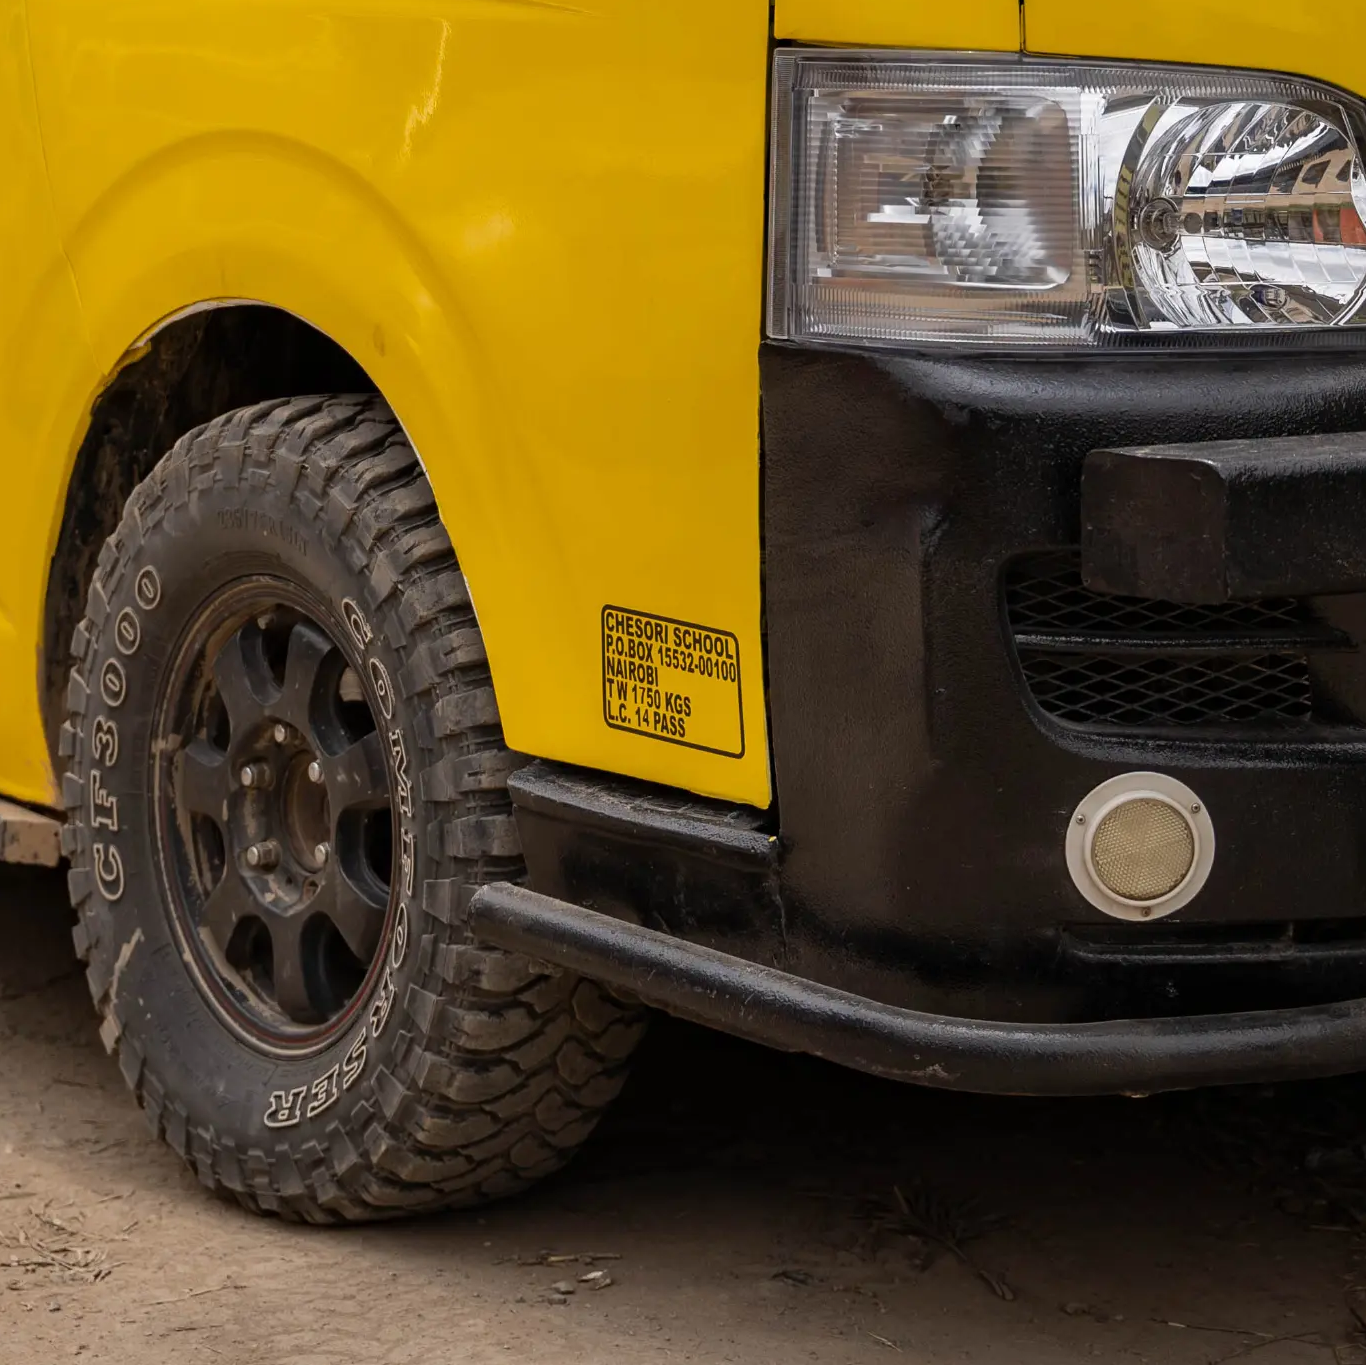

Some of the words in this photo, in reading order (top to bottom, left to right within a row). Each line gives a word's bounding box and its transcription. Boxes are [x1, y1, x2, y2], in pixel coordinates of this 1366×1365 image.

[605, 611, 669, 645] CHESORI
[673, 627, 734, 660] SCHOOL
[606, 634, 654, 663] P.O.BOX
[658, 645, 736, 683] 15532-00100
[606, 656, 659, 687] NAIROBI
[607, 700, 631, 724] L.C.
[635, 706, 650, 727] 14
[653, 711, 686, 738] PASS
[631, 684, 661, 709] 1750
[665, 691, 692, 717] KGS
[91, 565, 161, 901] CF3000
[264, 597, 416, 1128] COMFORSER
